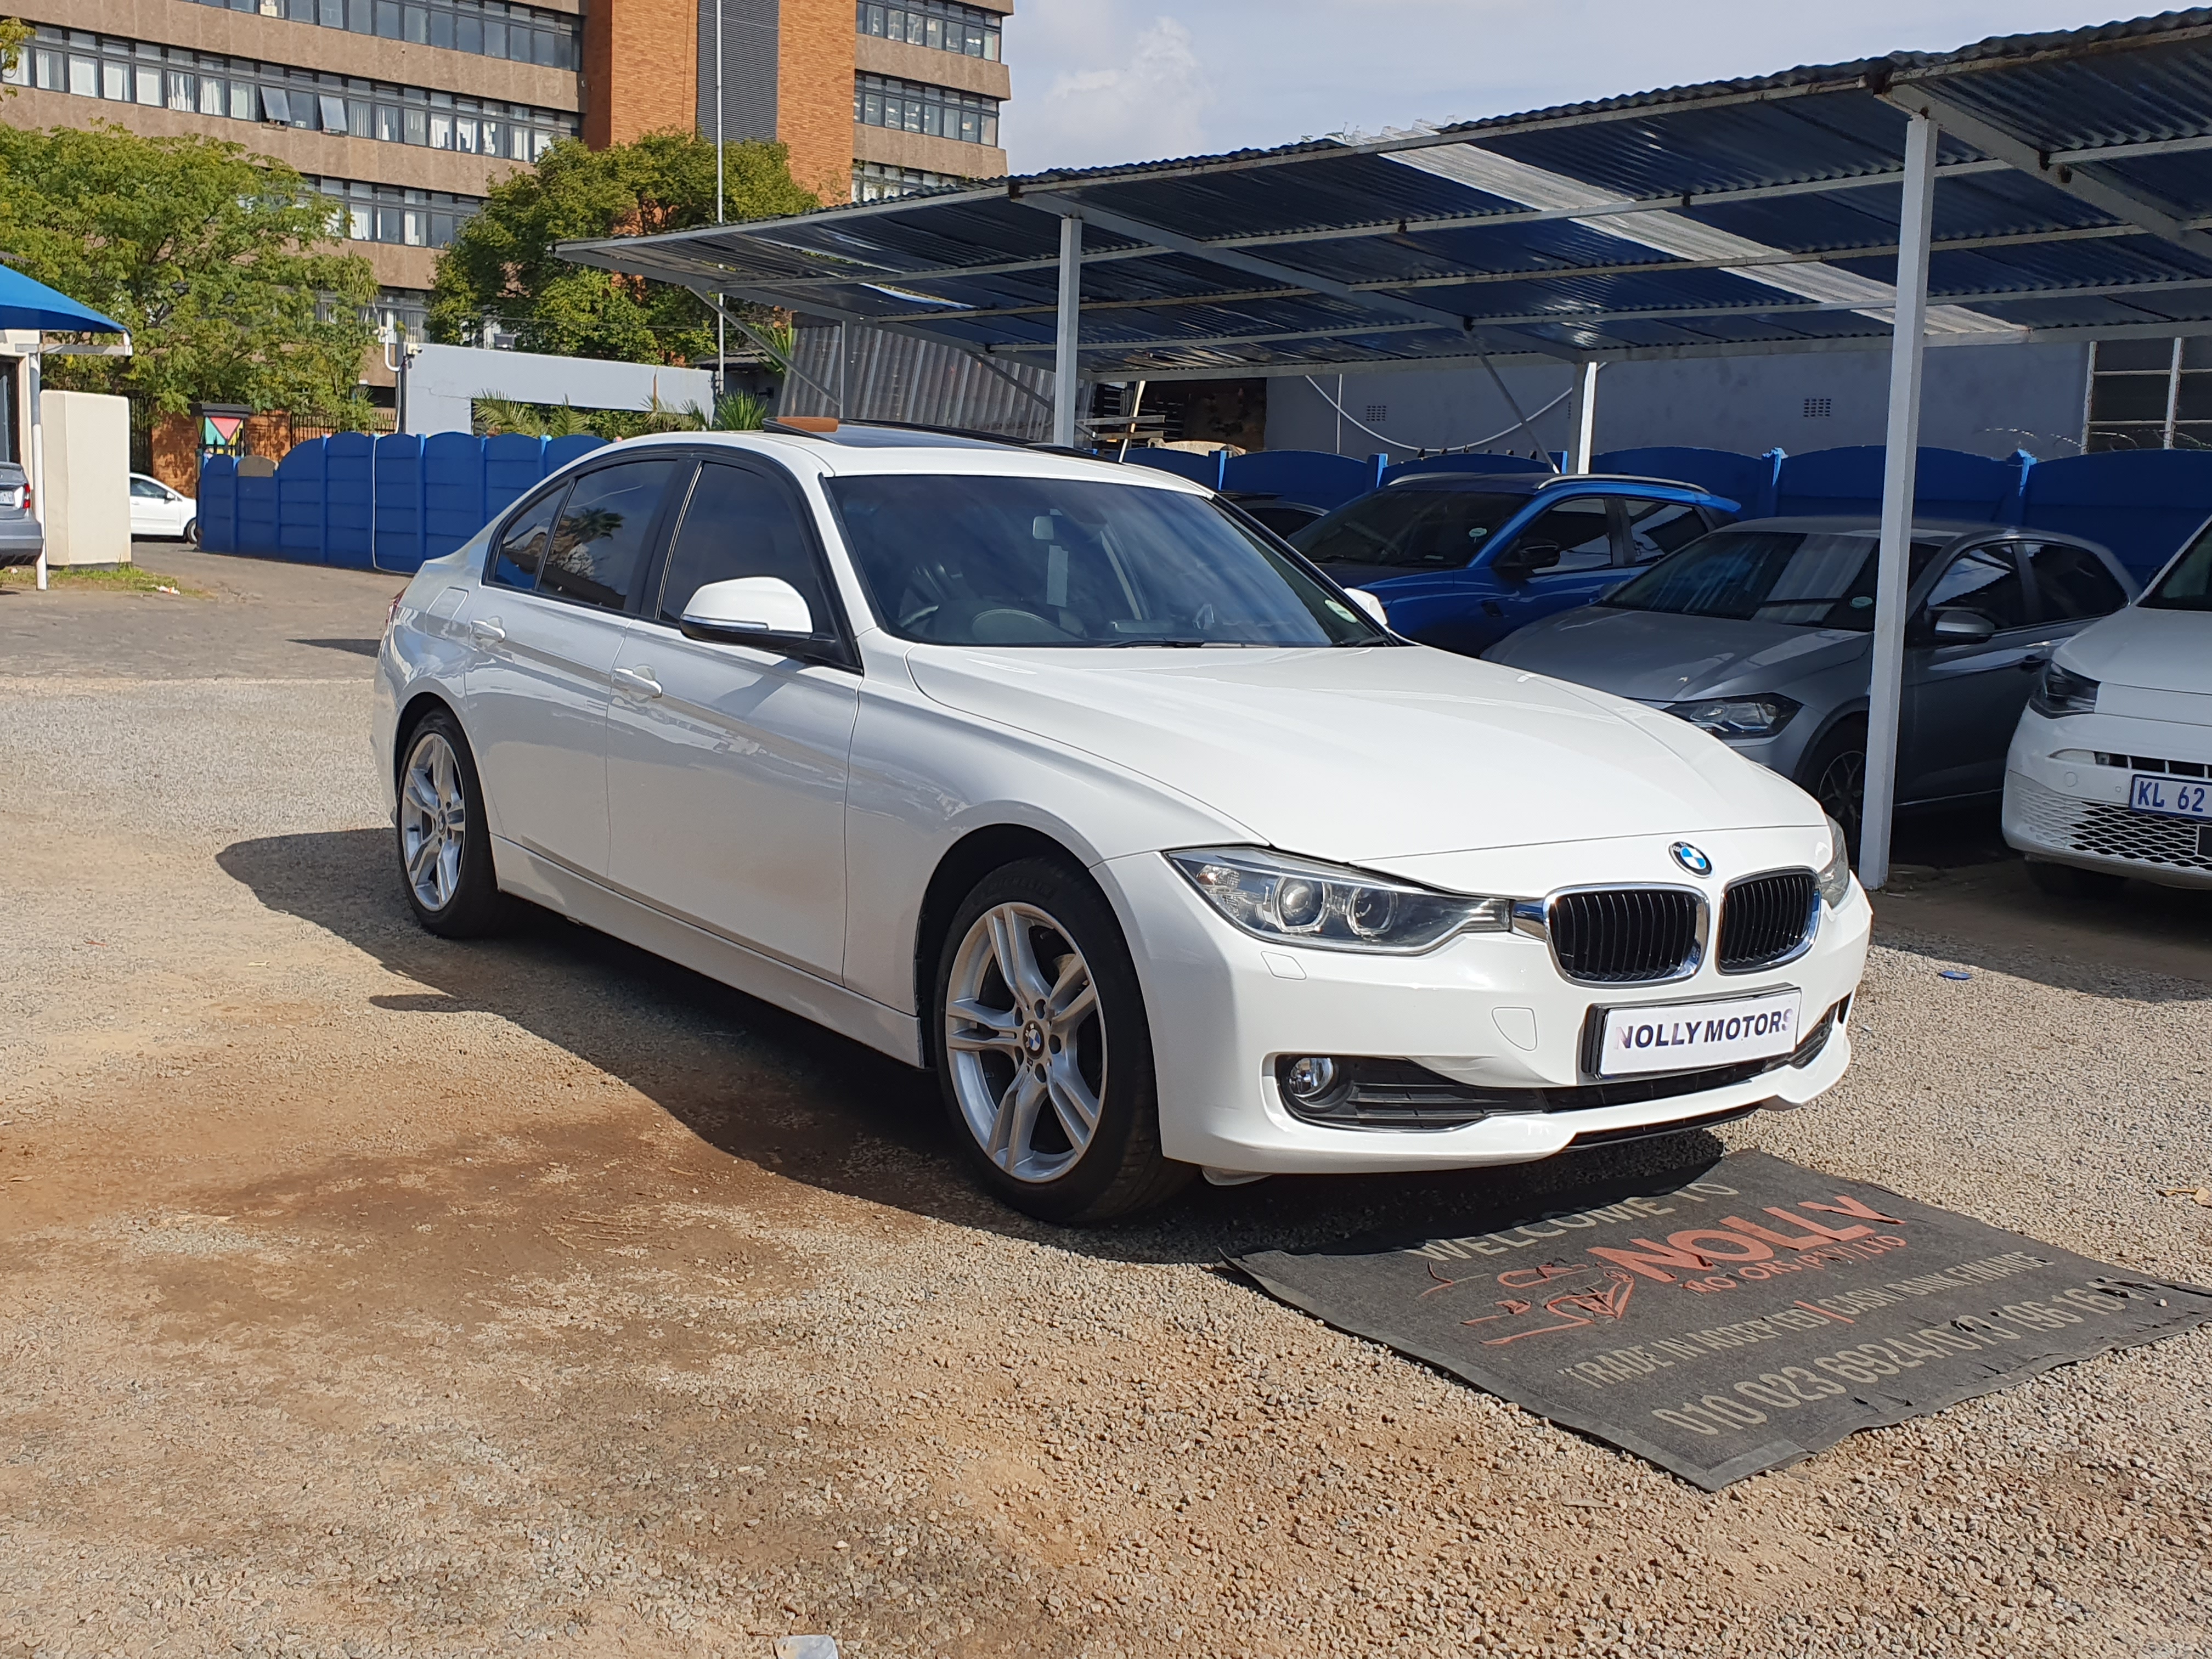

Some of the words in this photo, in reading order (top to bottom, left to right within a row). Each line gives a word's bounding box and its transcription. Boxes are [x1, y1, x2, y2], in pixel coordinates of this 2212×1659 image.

[2138, 781, 2165, 808] KL
[2177, 786, 2205, 812] 62
[1615, 1021, 1703, 1051] NOLLY
[1703, 1008, 1794, 1043] MOTORS
[1403, 1197, 1677, 1261] WELCOME
[1586, 1193, 1906, 1283] NOLLY
[1556, 1345, 1675, 1390] TRADE
[1650, 1337, 1708, 1361] IN
[1685, 1308, 1831, 1351] ACCEPTED
[1943, 1251, 2055, 1284] FINANCE
[1651, 1394, 1768, 1436] 010
[1733, 1366, 1847, 1409] 023
